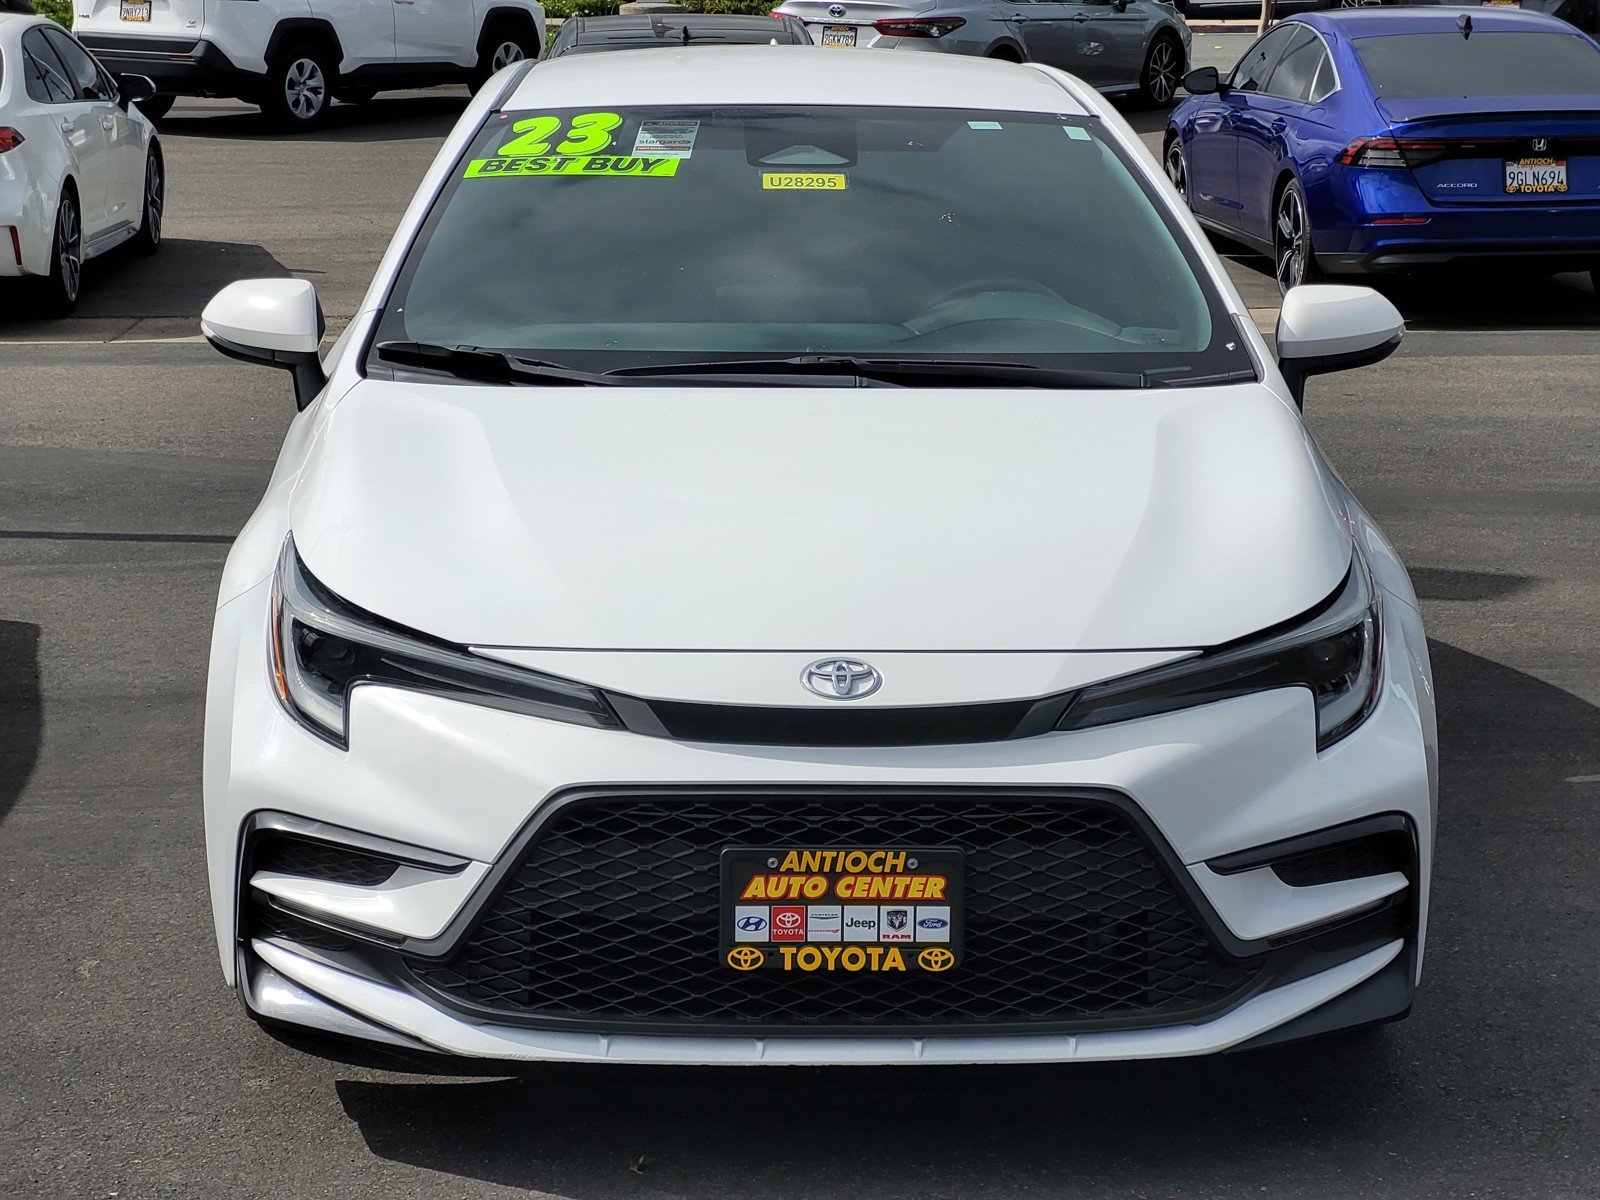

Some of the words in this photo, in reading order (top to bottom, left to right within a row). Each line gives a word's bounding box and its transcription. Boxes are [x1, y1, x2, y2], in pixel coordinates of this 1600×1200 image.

[825, 34, 854, 44] 9GKW789
[498, 112, 623, 157] 23
[478, 157, 580, 173] BEST
[583, 157, 670, 173] BUY
[770, 177, 837, 188] U28295
[1508, 170, 1563, 186] 9GLN694
[779, 850, 907, 873] ANTIOCH
[742, 875, 829, 900] AUTO
[834, 875, 947, 900] CENTER
[845, 917, 876, 930] Jeep
[772, 928, 804, 937] TOYOTA
[779, 947, 907, 971] TOYOTA
